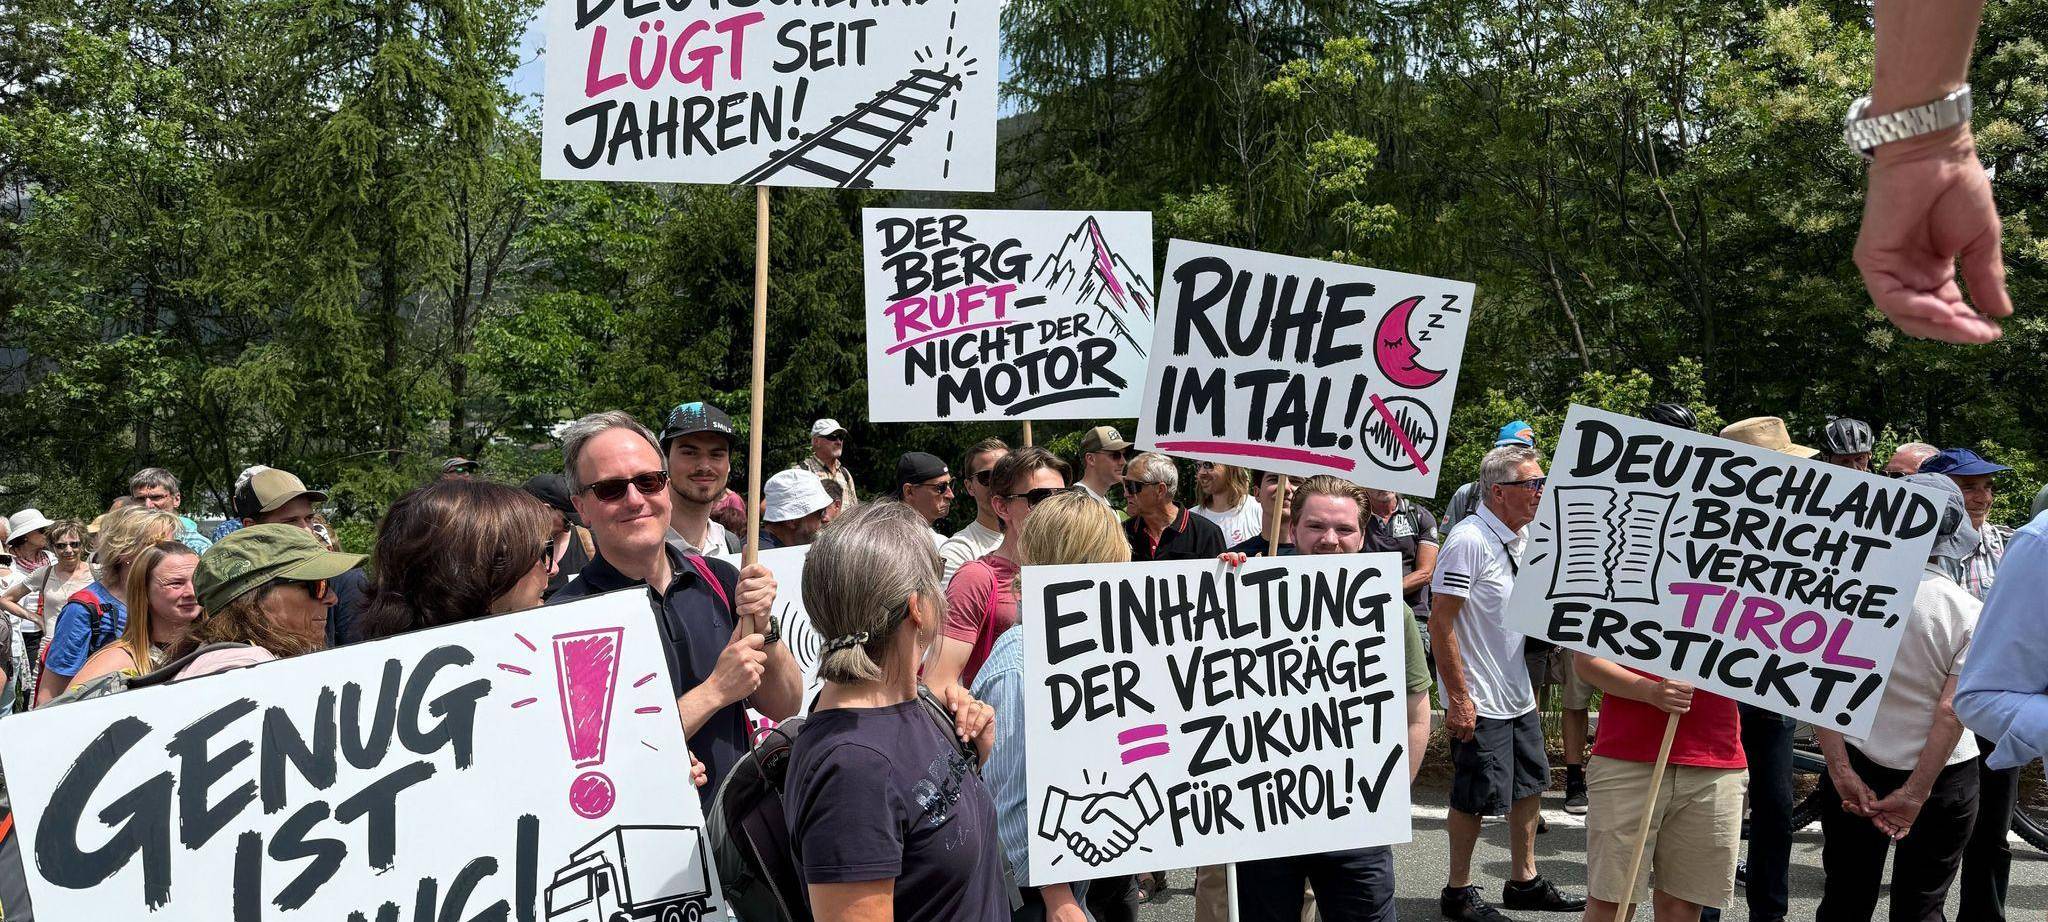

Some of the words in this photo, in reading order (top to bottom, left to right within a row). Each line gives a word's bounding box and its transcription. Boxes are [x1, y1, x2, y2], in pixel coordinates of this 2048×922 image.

[585, 11, 765, 97] LÜGT
[773, 19, 878, 73] SEIT
[564, 77, 809, 169] JAHREN!
[876, 215, 976, 257] DER
[881, 238, 1032, 301] BERG
[904, 323, 1034, 386] NICHT
[1037, 313, 1095, 344] DER
[1173, 257, 1376, 368] RUHE
[937, 338, 1128, 418] MOTOR
[1156, 365, 1226, 437] IM
[1234, 369, 1368, 450] TAL!
[1570, 420, 1938, 540] DEUTSCHLAND
[1690, 498, 1892, 572] BRICHT
[1044, 568, 1392, 665] EINHALTUNG
[1668, 583, 1876, 669] TIROL
[1686, 540, 1900, 628] VERTRÄGE,
[1045, 661, 1155, 730] DER
[1167, 635, 1387, 712] VERTRÄGE
[1547, 602, 1883, 726] ERSTICKT!
[1180, 691, 1394, 777] ZUKUNFT
[35, 645, 492, 913] GENUG
[1167, 781, 1244, 847] FÜR
[233, 761, 437, 922] IST
